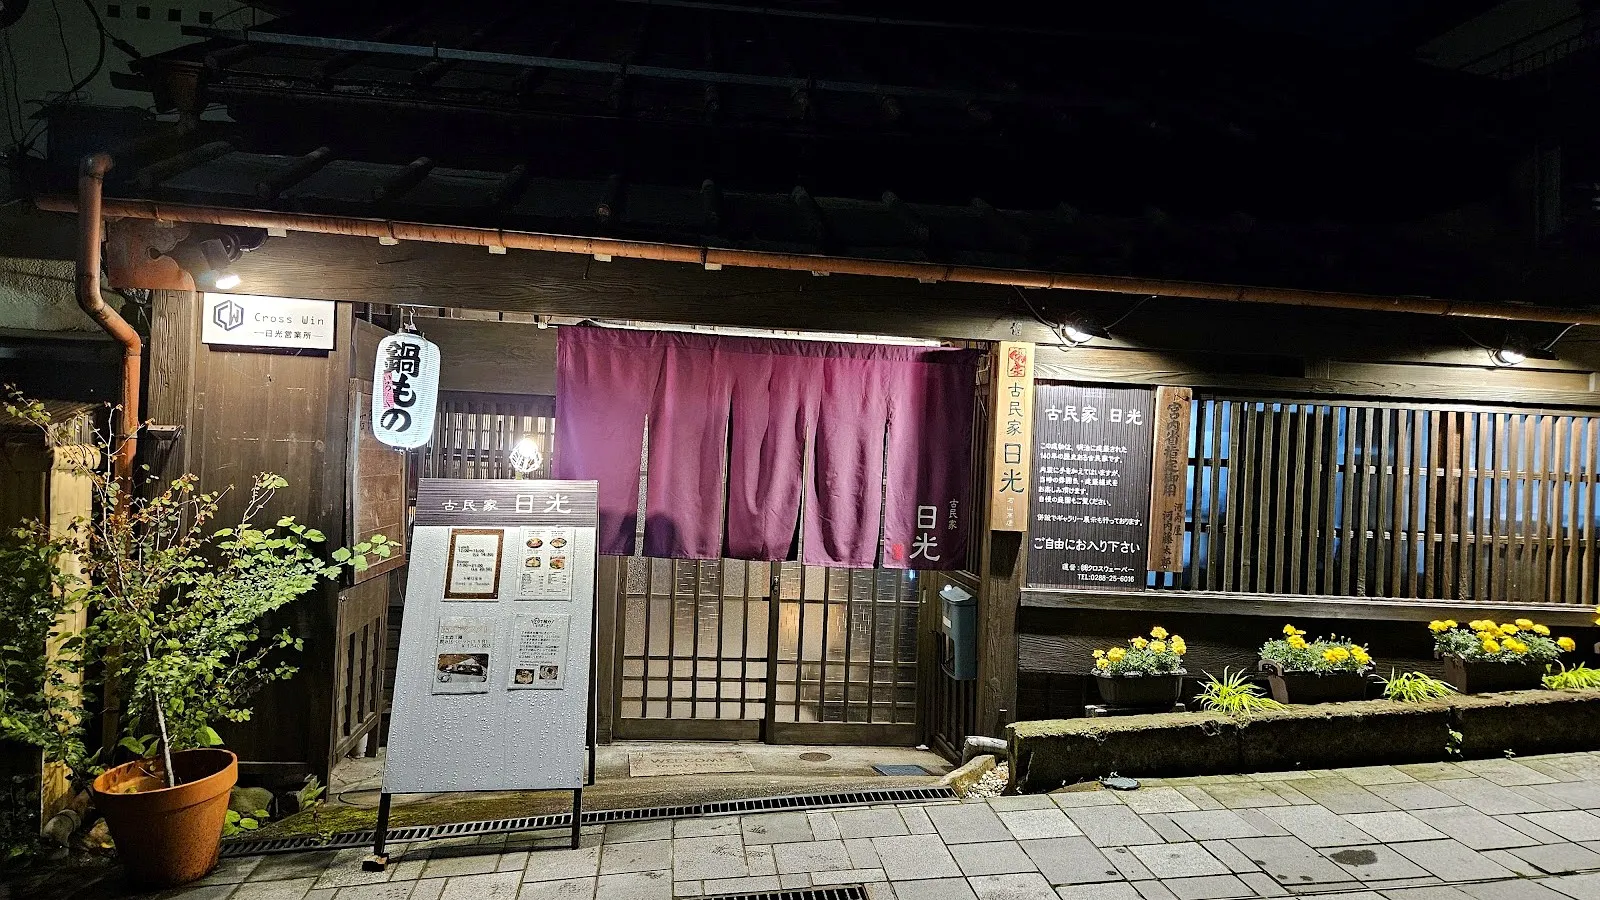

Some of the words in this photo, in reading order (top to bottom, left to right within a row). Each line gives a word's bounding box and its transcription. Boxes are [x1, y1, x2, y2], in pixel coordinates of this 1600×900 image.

[254, 312, 293, 324] Cross
[301, 315, 324, 325] Win
[380, 341, 421, 433] 鍋もの
[1006, 382, 1025, 436] 古民家
[1045, 404, 1099, 424] 古民家
[1110, 407, 1143, 426] 日光
[999, 442, 1025, 494] 日光
[441, 499, 499, 512] 古民家
[515, 493, 572, 514] 日光
[948, 498, 960, 531] 古民家
[909, 505, 941, 562] 日光
[1034, 536, 1141, 554] ご自由にお入り下さい
